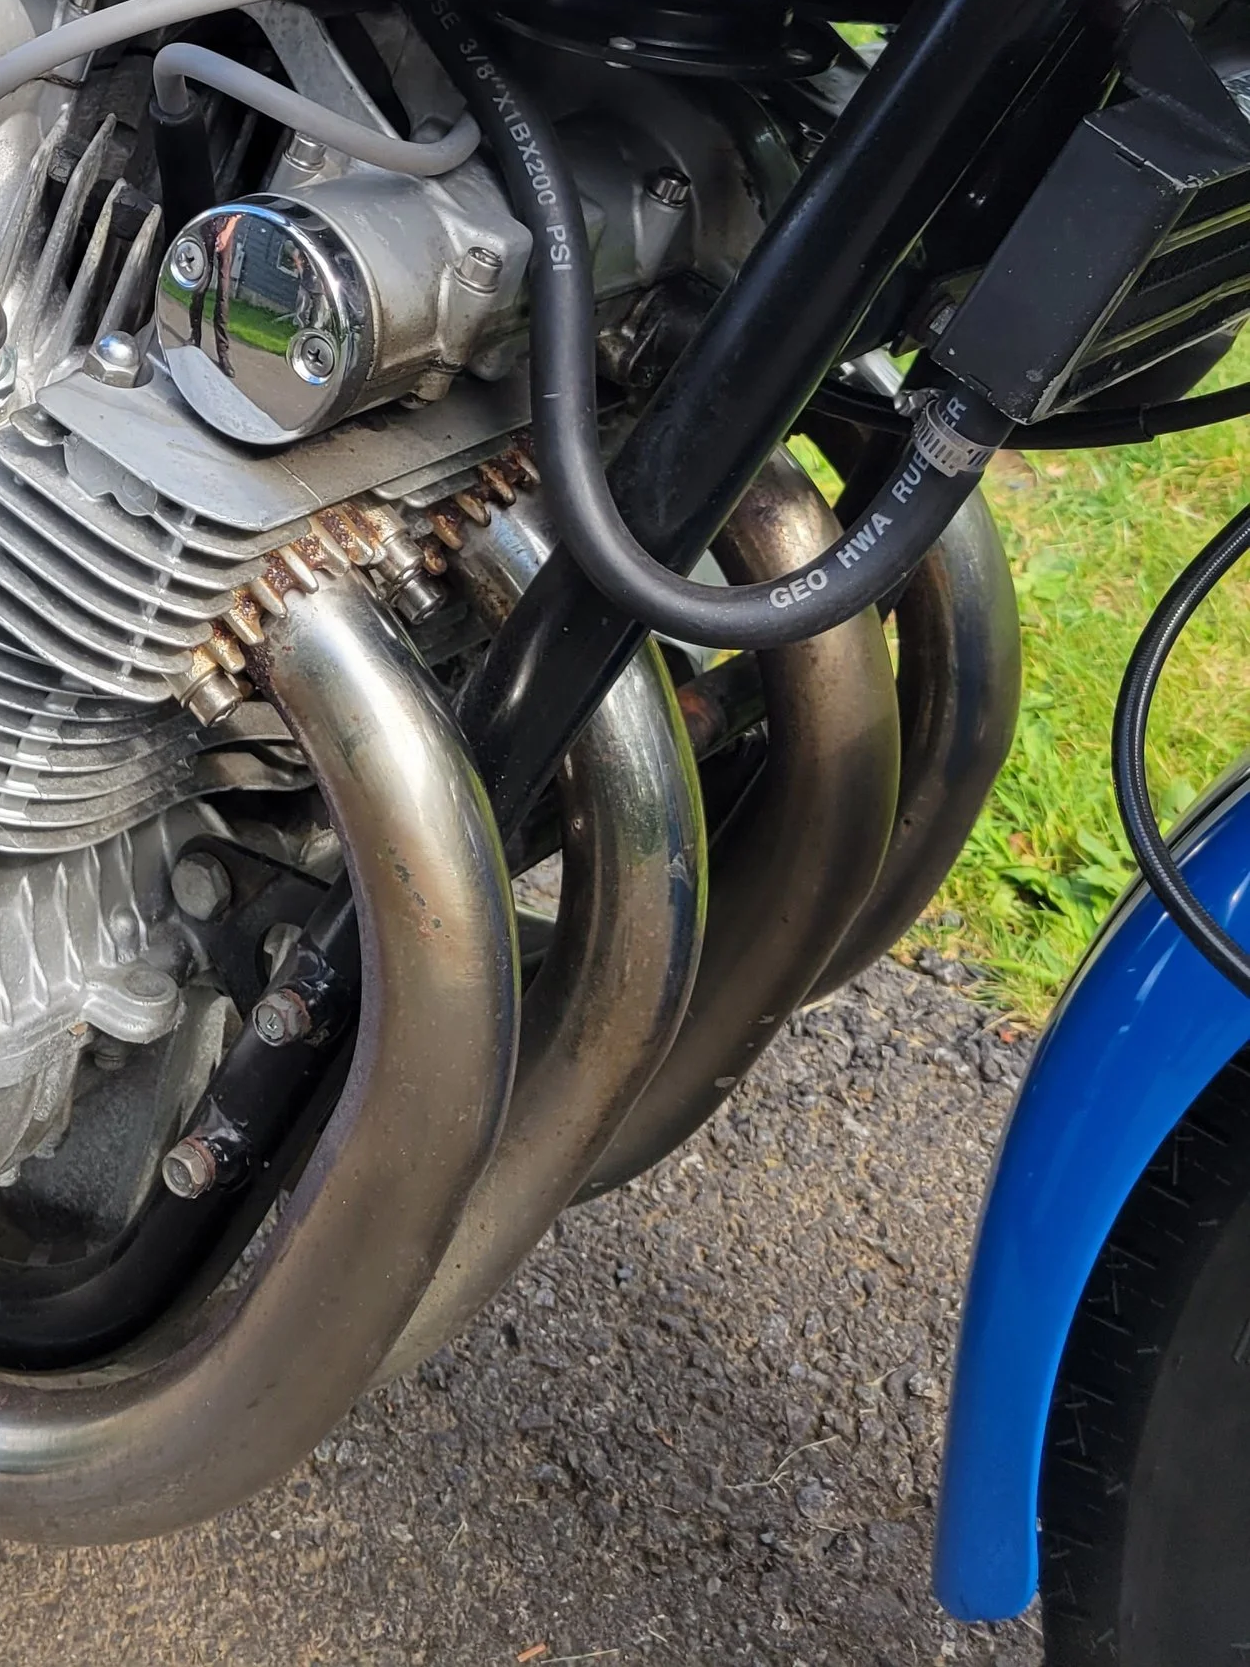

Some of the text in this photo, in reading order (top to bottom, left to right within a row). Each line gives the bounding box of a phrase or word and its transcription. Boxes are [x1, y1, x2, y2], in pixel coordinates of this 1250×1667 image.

[546, 224, 572, 271] PSI
[769, 568, 829, 609] GEO
[835, 512, 893, 570] HWA
